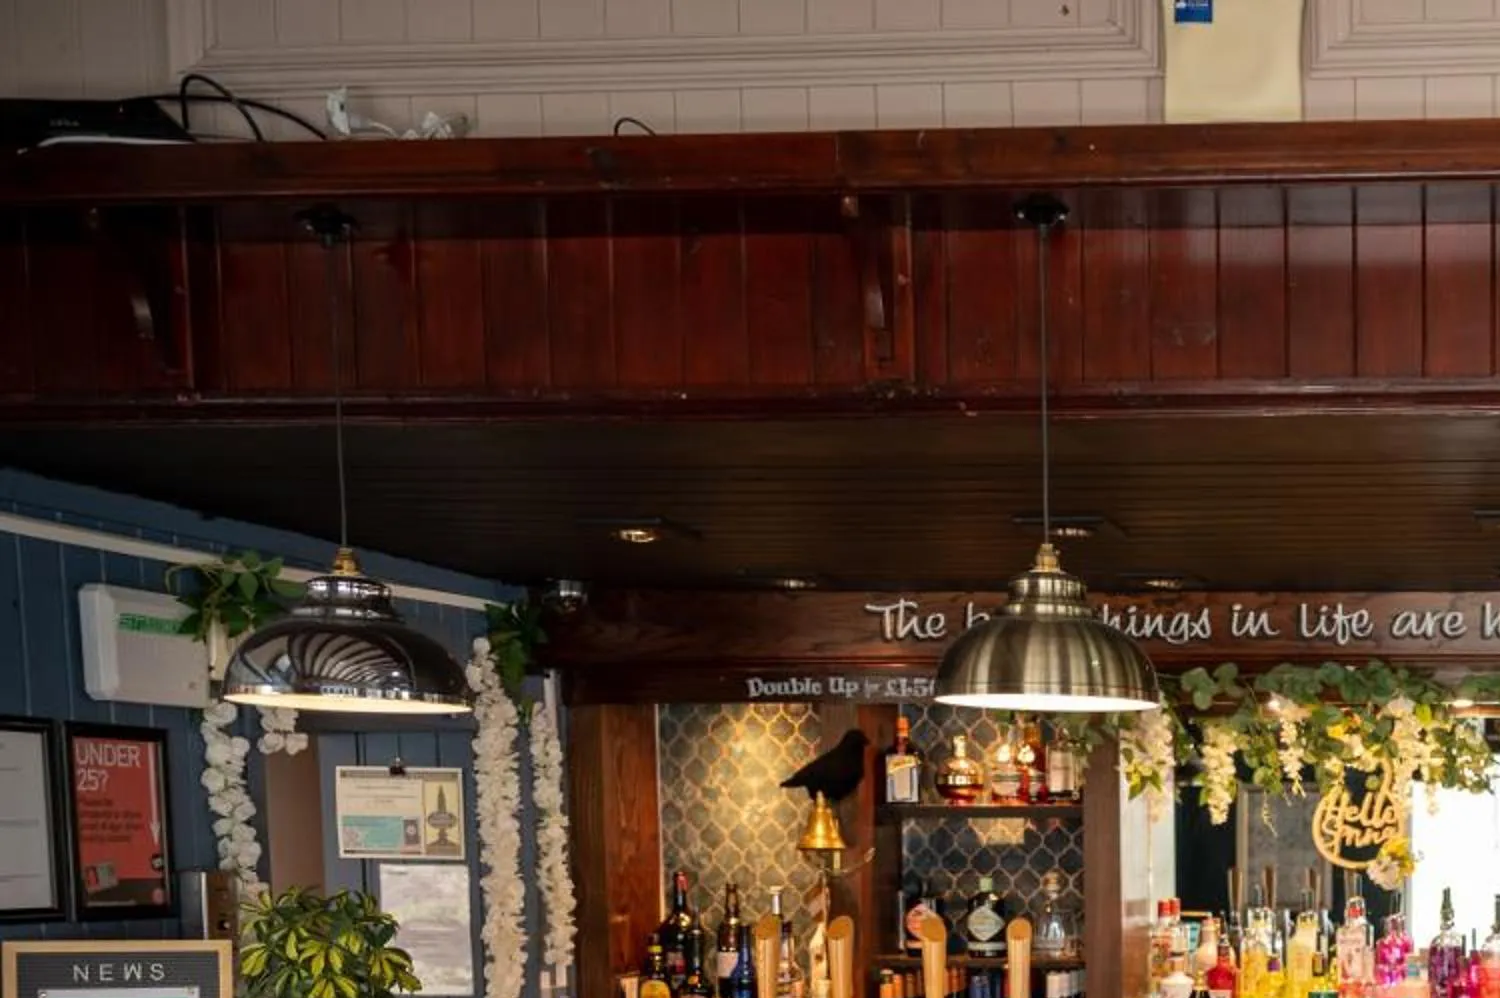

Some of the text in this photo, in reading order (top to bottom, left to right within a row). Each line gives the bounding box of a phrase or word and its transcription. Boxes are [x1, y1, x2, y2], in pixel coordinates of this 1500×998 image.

[865, 600, 948, 640] The
[1102, 603, 1211, 644] hings
[1231, 603, 1280, 638] in
[1300, 603, 1373, 645] life
[1391, 610, 1467, 638] are
[746, 676, 822, 697] Double
[829, 677, 858, 698] Up
[75, 744, 141, 768] UNDER
[77, 768, 110, 791] 25?
[72, 962, 166, 983] NEWS
